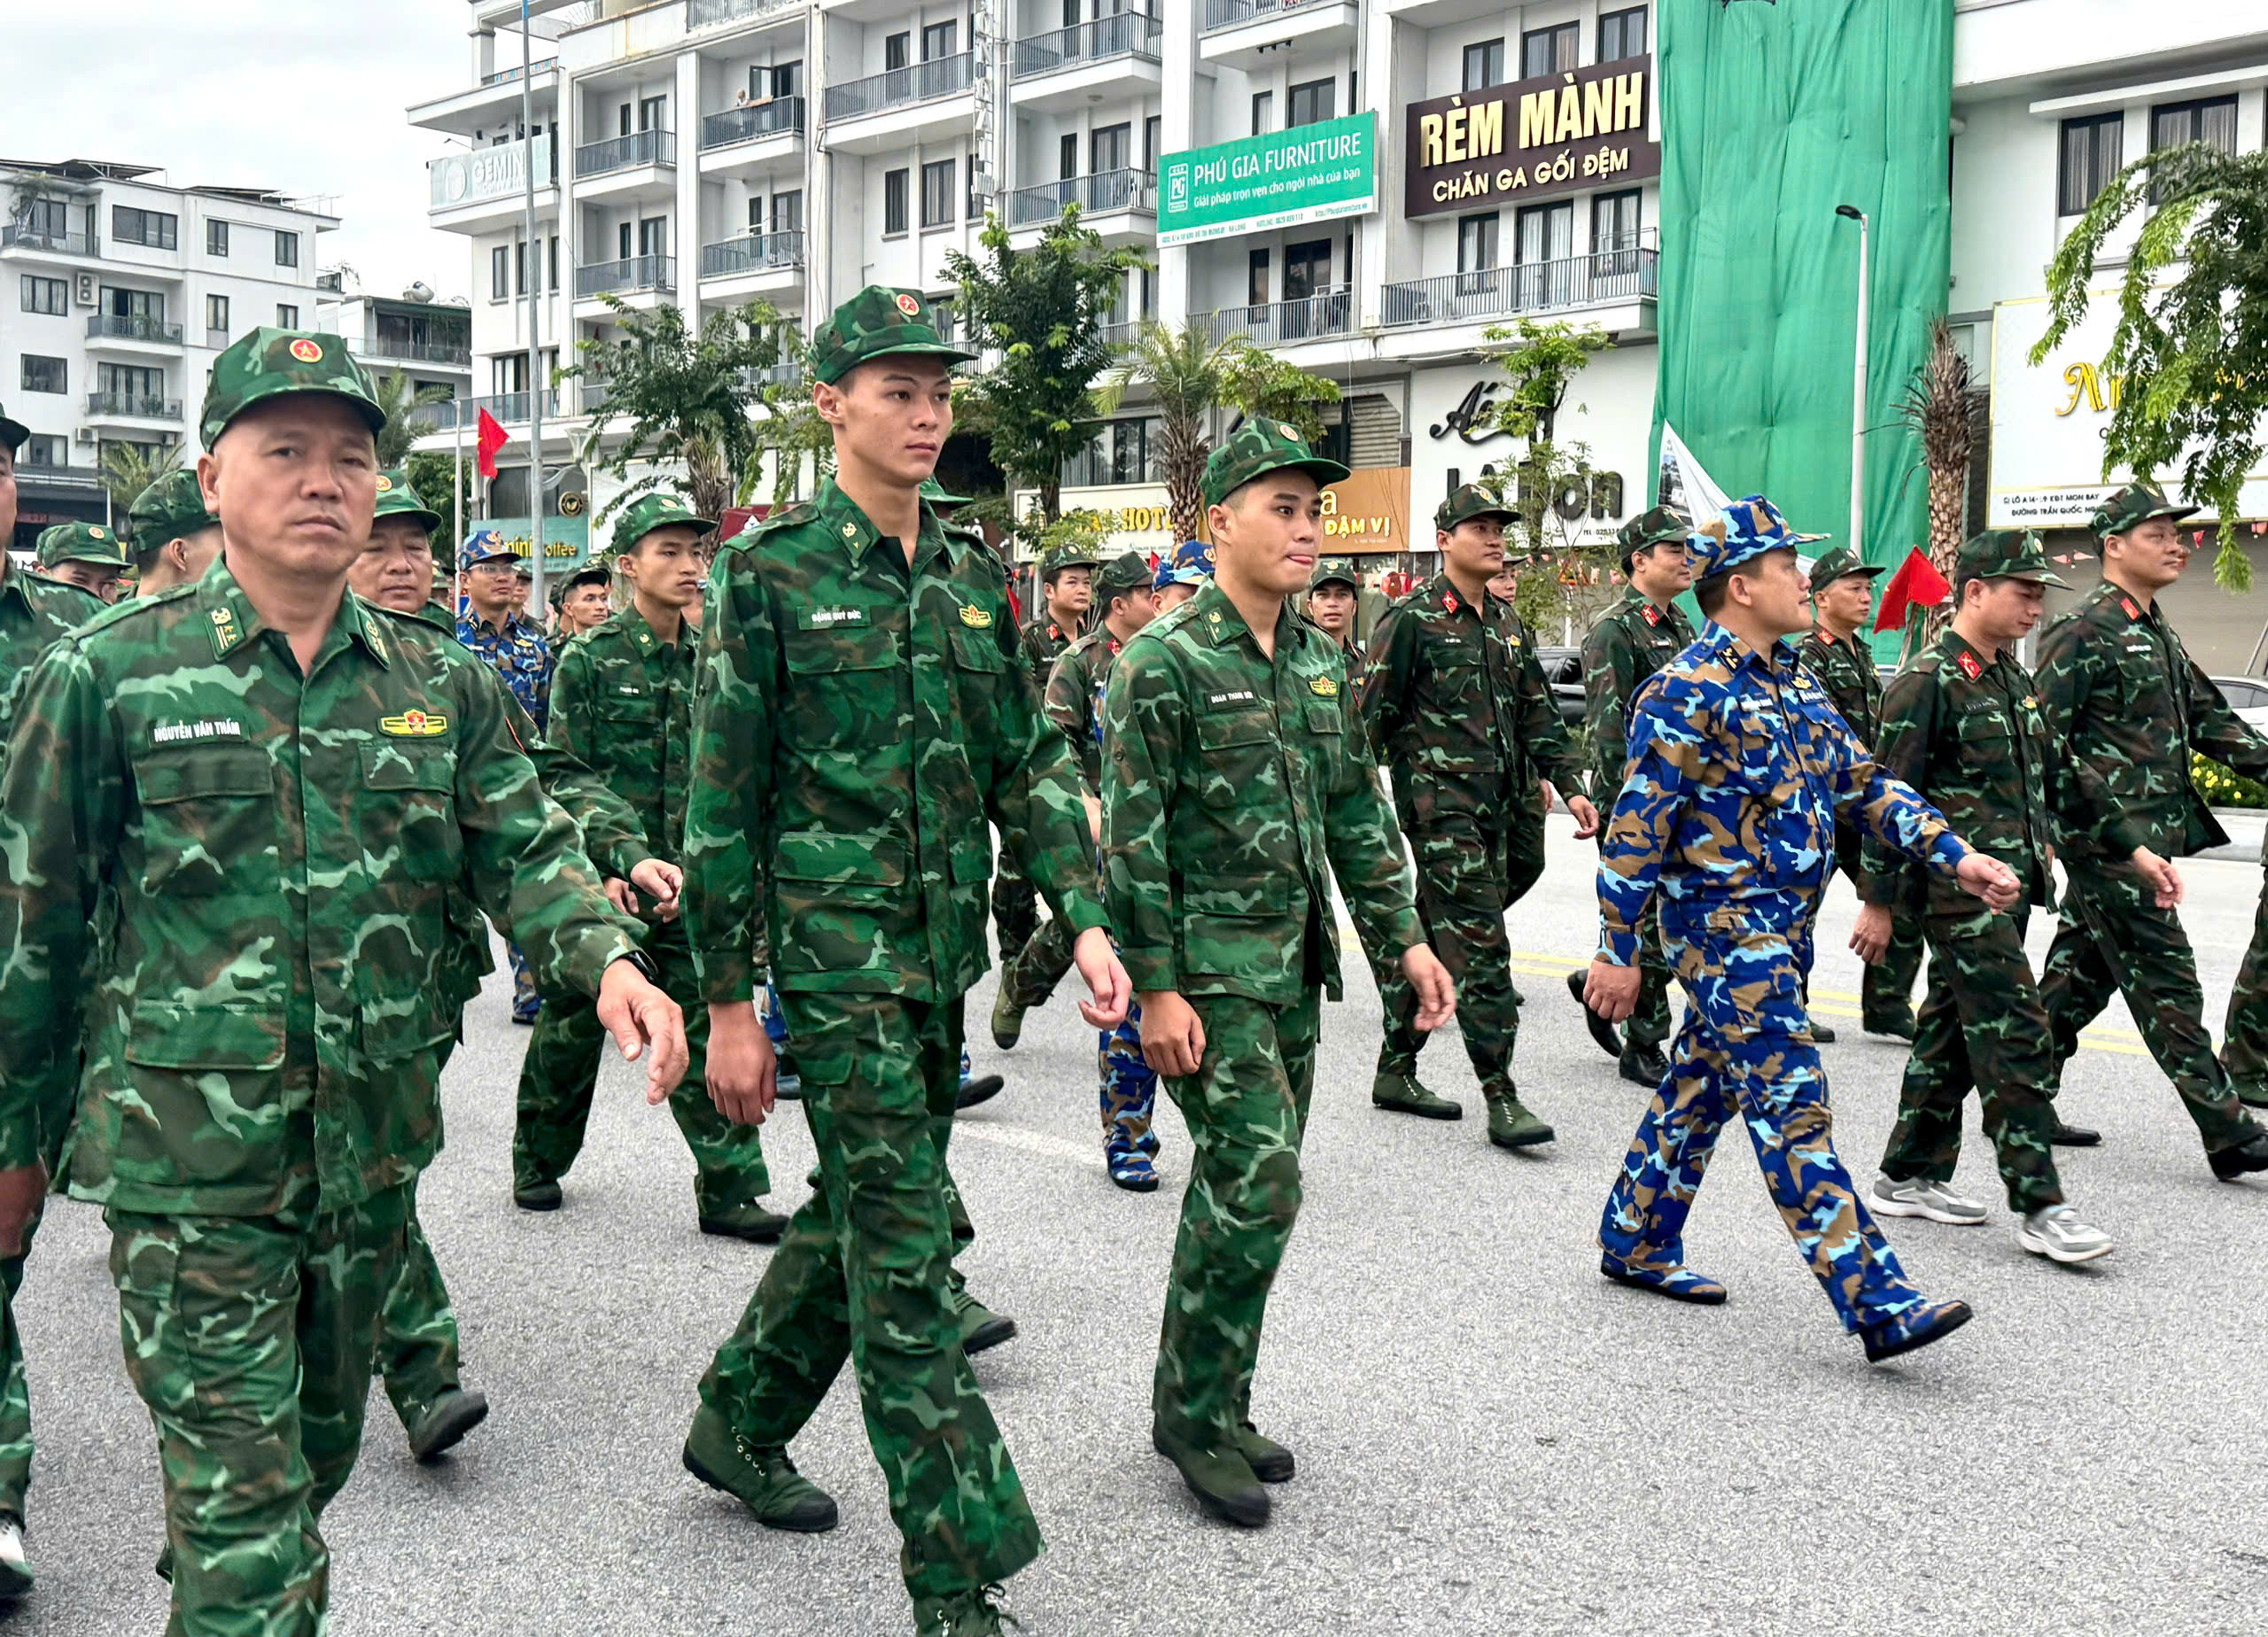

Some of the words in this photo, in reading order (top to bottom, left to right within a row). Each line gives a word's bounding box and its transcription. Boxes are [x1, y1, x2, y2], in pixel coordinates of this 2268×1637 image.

[1420, 96, 1503, 168] RÈM
[1518, 72, 1643, 150] MÀNH
[472, 150, 525, 184] GEMIN
[1194, 158, 1226, 187] PHÚ
[1232, 156, 1260, 180] GIA
[1265, 131, 1362, 173] FURNITURE
[1433, 170, 1489, 203] CHĂN
[1495, 167, 1527, 191] GA
[1534, 149, 1576, 185] GỐI
[1582, 145, 1628, 180] ĐỆM
[1270, 181, 1285, 193] cho
[1307, 172, 1324, 187] nhà
[1343, 166, 1361, 181] bạn
[1121, 507, 1175, 531] HOT
[1324, 516, 1366, 539] ĐẬM
[1370, 516, 1390, 537] VỊ
[544, 541, 577, 556] offee
